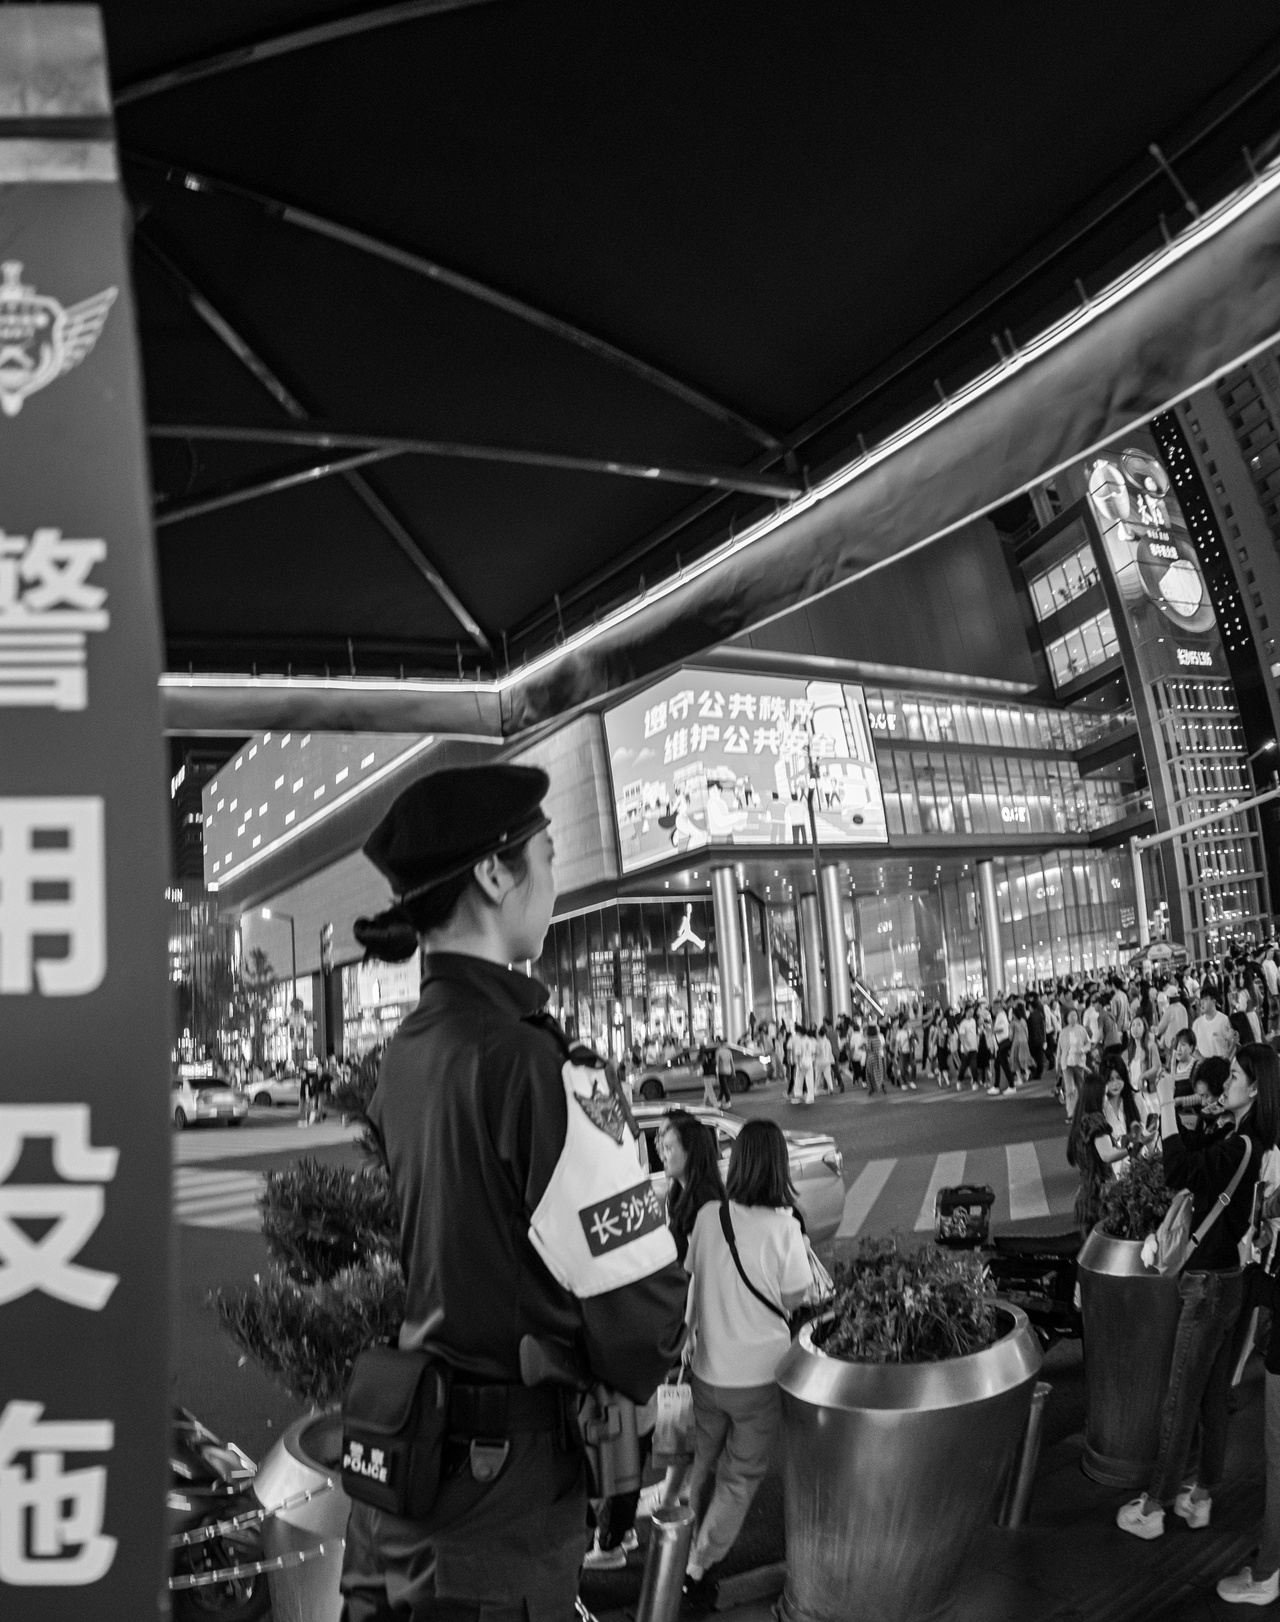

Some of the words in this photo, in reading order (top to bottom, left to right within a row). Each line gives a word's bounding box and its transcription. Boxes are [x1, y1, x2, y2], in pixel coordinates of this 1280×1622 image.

[643, 688, 815, 740] 遵守公共秩序
[663, 722, 837, 766] 维护公共安全
[343, 1453, 388, 1483] POLICE
